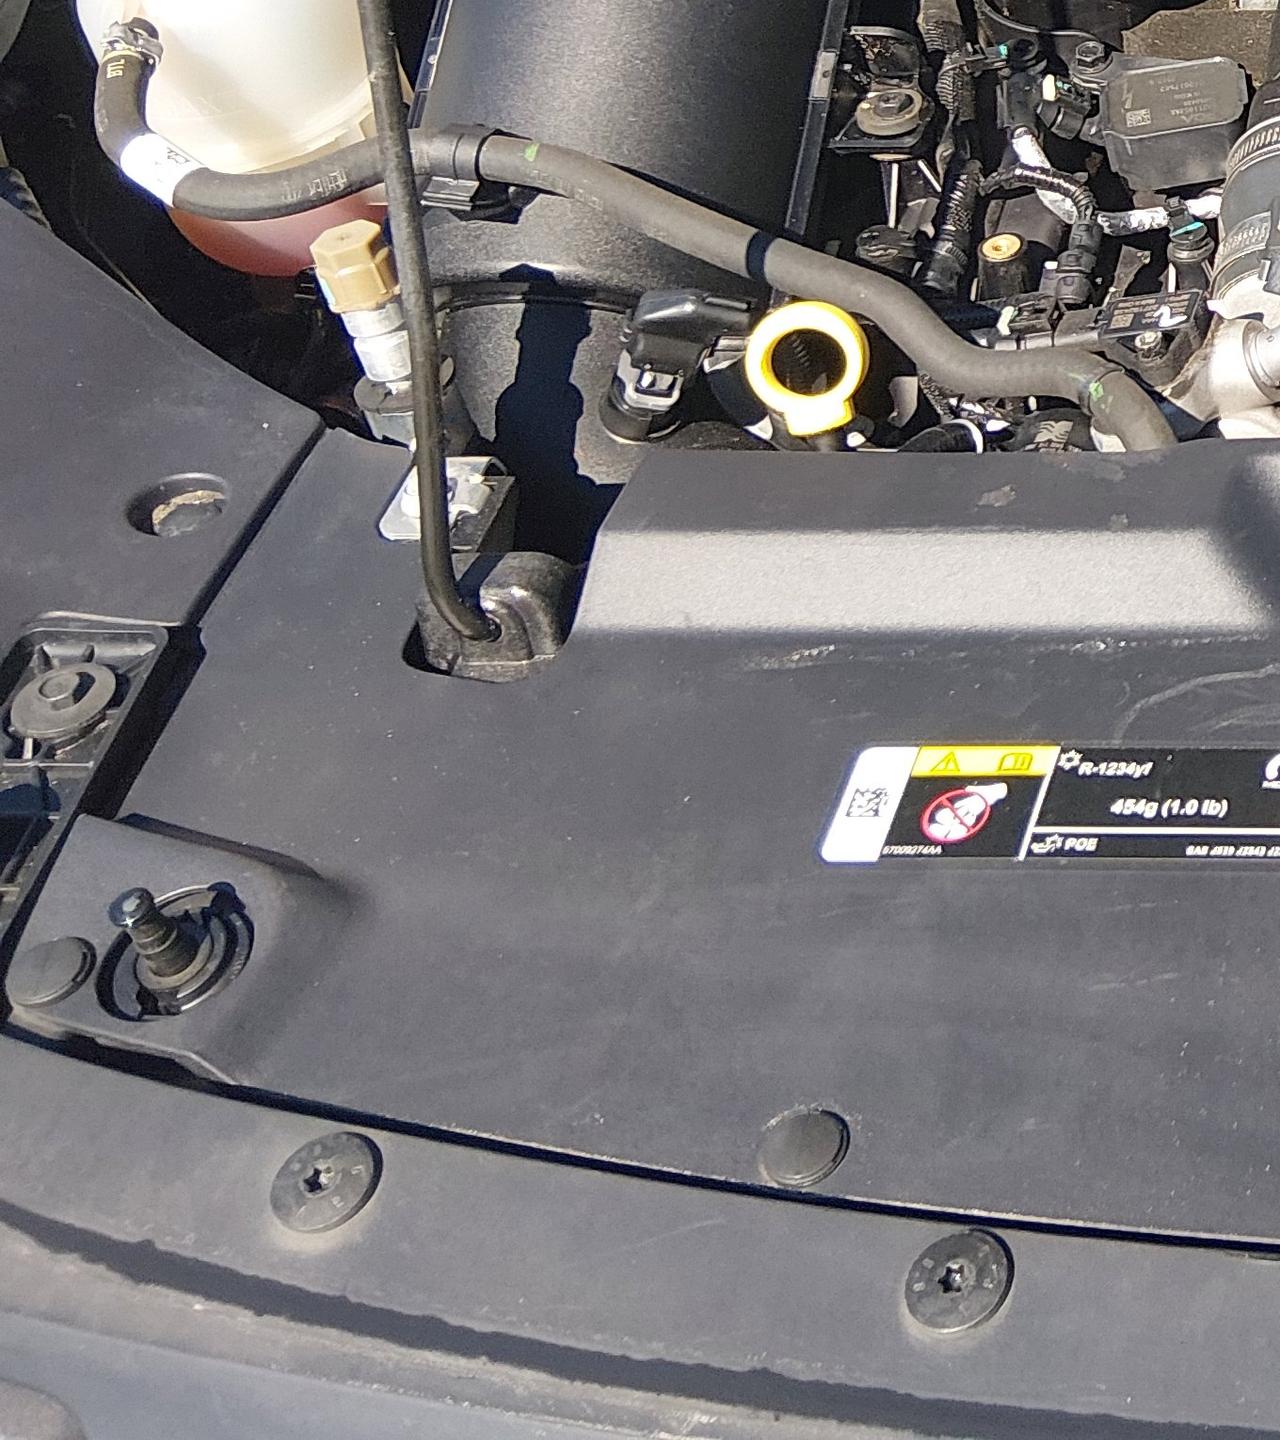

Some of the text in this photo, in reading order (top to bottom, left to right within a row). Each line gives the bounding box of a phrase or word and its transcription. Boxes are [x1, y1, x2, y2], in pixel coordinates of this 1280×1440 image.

[1077, 761, 1154, 779] R-1234yf
[1109, 797, 1230, 820] 454g (1.0 lb)
[1063, 836, 1099, 852] POE
